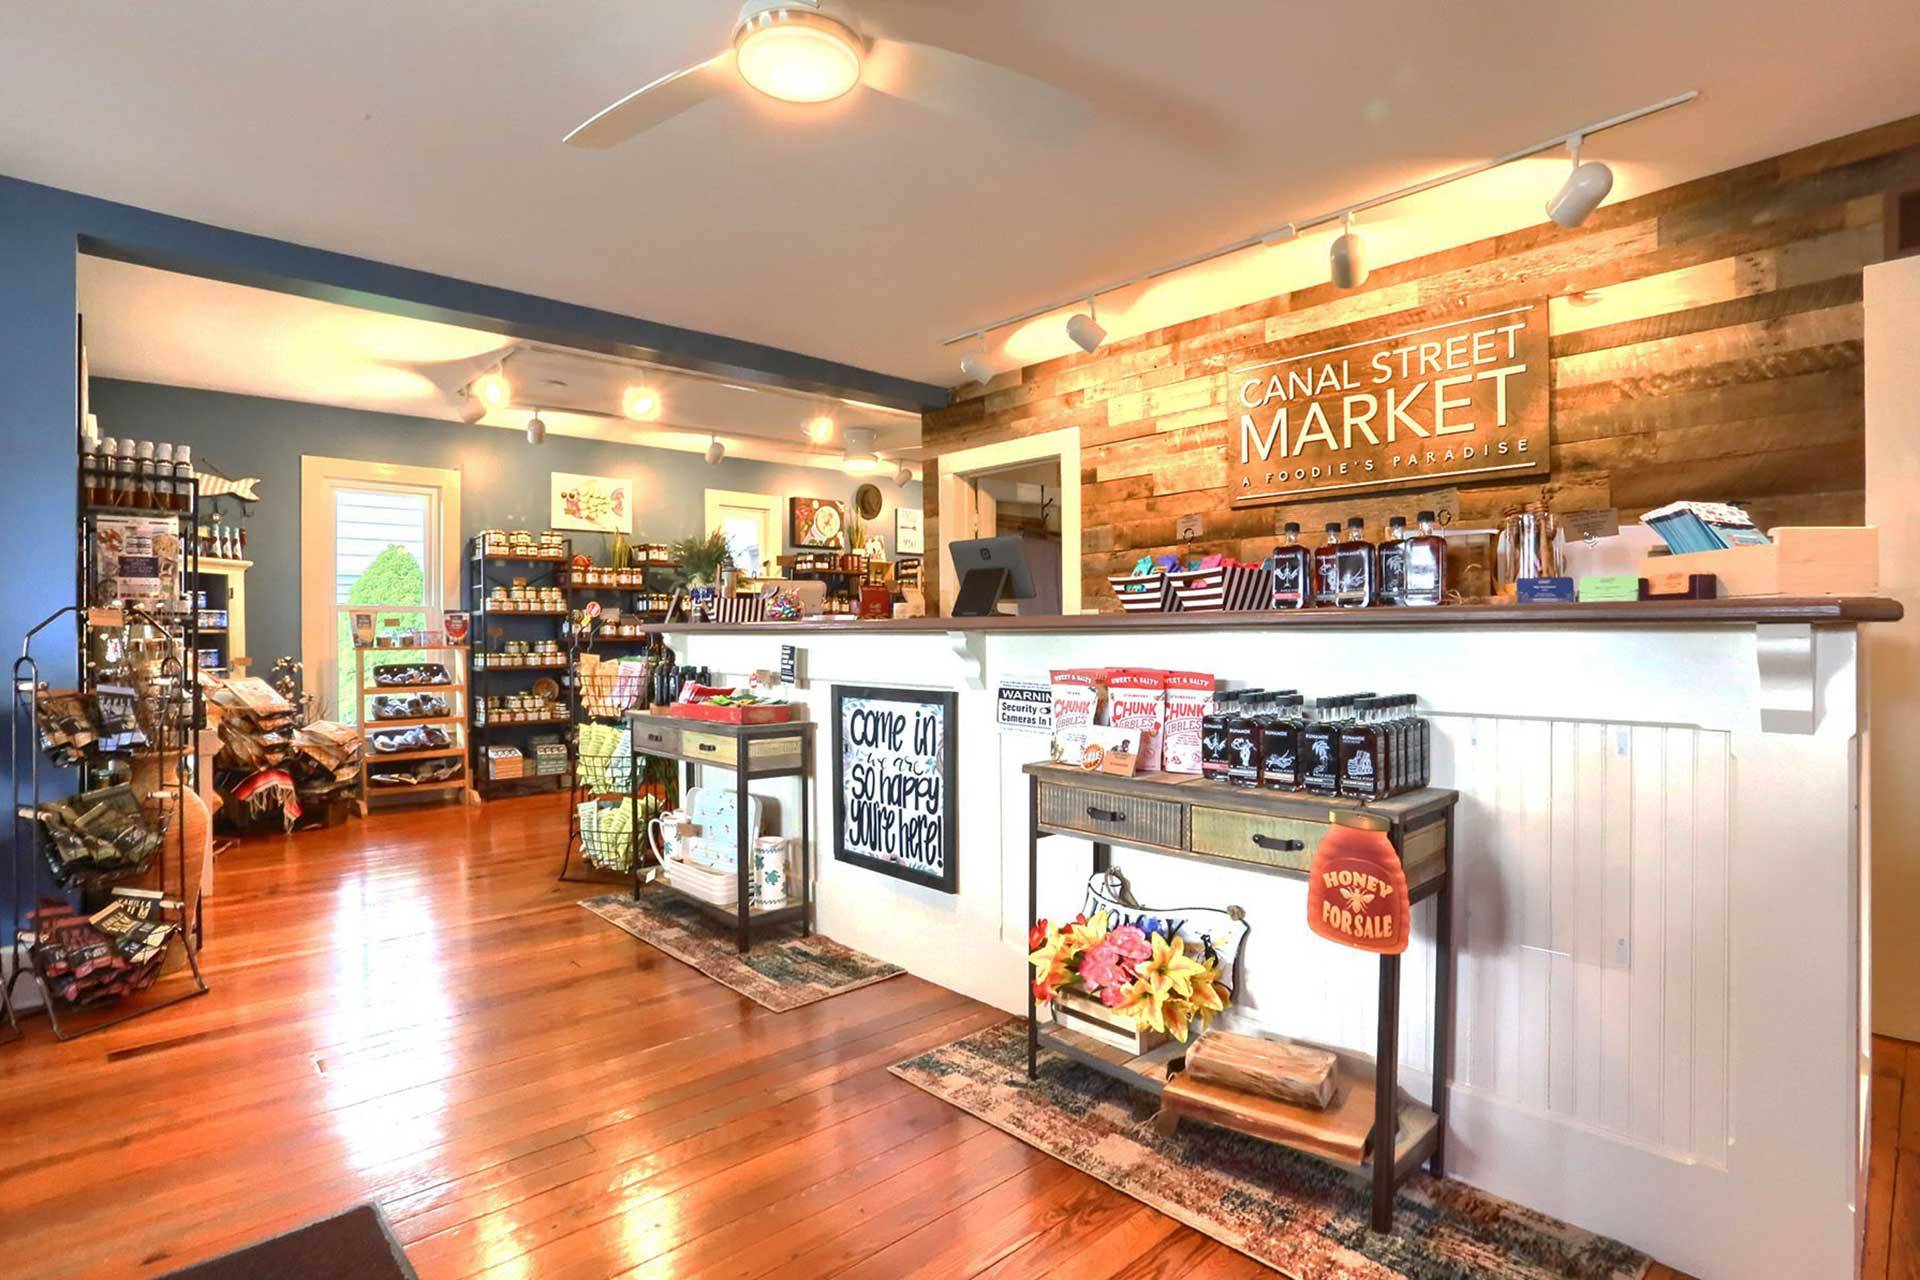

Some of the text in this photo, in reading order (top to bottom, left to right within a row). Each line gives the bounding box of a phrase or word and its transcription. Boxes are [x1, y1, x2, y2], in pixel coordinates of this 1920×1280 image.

[1239, 322, 1527, 408] CANAL STREET
[1240, 364, 1527, 464] MARKET
[1242, 438, 1528, 487] A FOODIE'S PARADISE
[1001, 702, 1037, 715] Security
[1002, 689, 1051, 703] WARNIN
[1055, 699, 1090, 718] CHUNK
[1113, 700, 1157, 722] CHUNK
[850, 708, 936, 757] come in
[1001, 712, 1037, 725] Cameras
[879, 769, 940, 815] happy
[899, 808, 944, 868] here!
[1322, 870, 1394, 898] HONEY
[1322, 900, 1393, 939] FOR SALE
